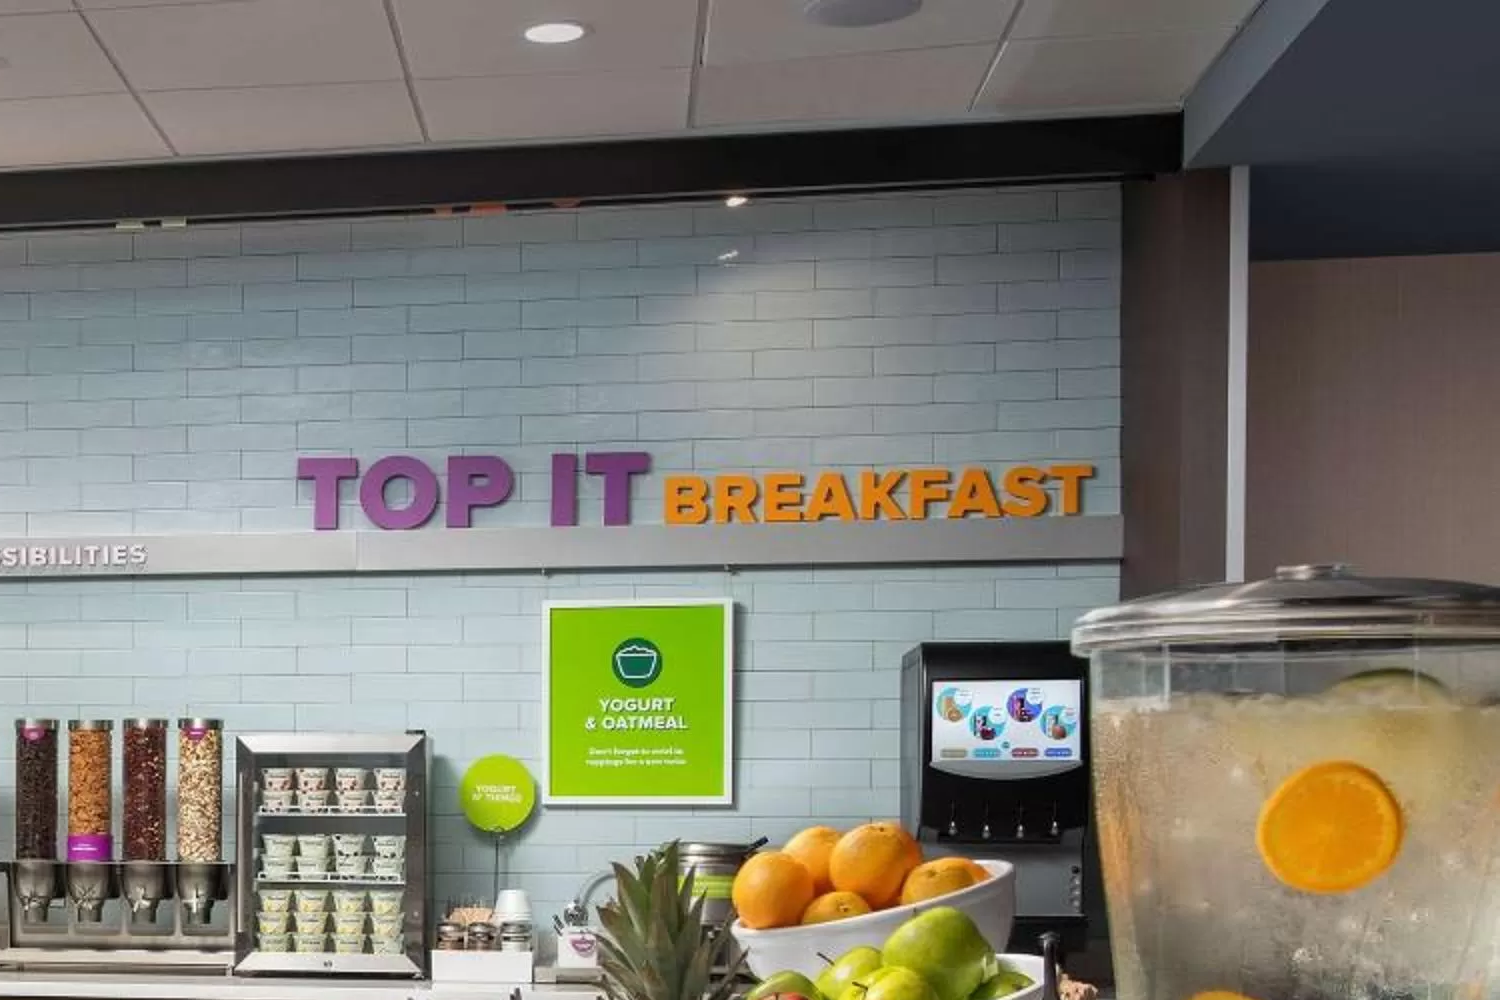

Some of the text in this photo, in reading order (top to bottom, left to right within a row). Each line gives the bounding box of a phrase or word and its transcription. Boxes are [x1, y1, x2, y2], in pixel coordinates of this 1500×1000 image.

[297, 452, 1093, 530] TOP IT BREAKFAST
[599, 697, 676, 712] YOGURT
[585, 715, 689, 730] & OATMEAL
